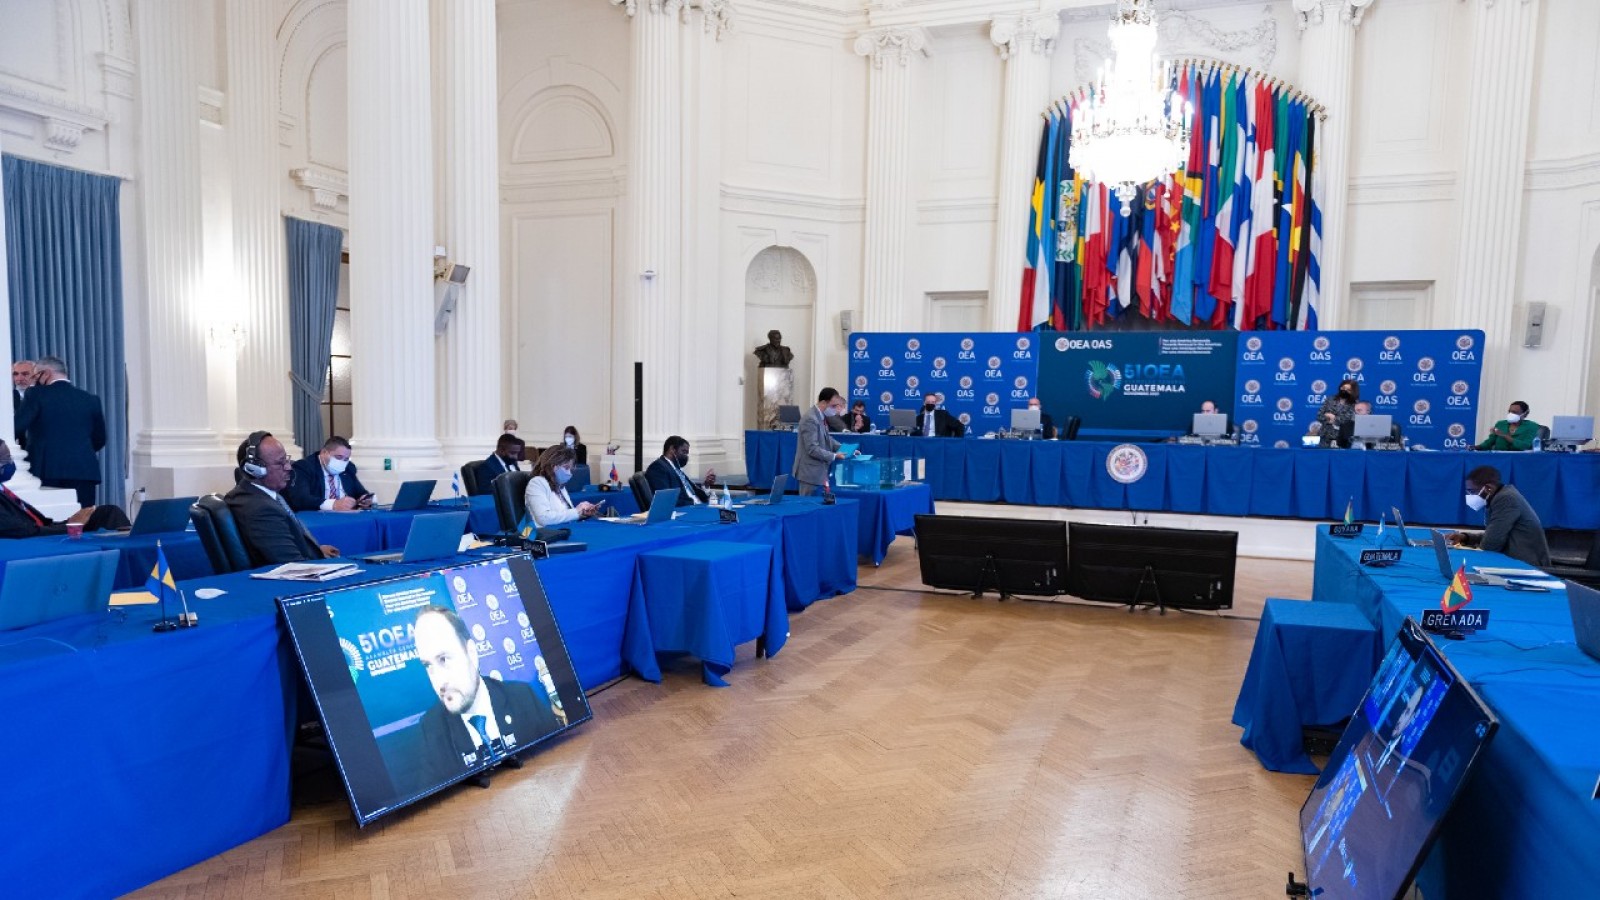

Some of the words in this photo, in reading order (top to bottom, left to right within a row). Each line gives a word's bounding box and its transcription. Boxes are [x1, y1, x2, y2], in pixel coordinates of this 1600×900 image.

[1070, 340, 1089, 349] OEA
[1092, 340, 1112, 349] OAS
[854, 351, 870, 359] OEA
[904, 352, 922, 360] OAS
[958, 351, 976, 360] OEA
[1014, 350, 1031, 359] OEA
[1243, 352, 1264, 360] OEA
[1310, 352, 1332, 360] OAS
[1380, 351, 1402, 360] OEA
[1452, 350, 1474, 360] OEA
[931, 370, 948, 378] OEA
[984, 370, 1002, 378] OEA
[1275, 372, 1296, 381] OEA
[1343, 372, 1364, 382] OEA
[1413, 372, 1436, 382] OEA
[956, 390, 974, 398] OAS
[1011, 390, 1029, 398] OEA
[1242, 395, 1262, 404] OEA
[1376, 396, 1398, 405] OAS
[1446, 396, 1470, 406] OEA
[984, 406, 1000, 414] OEA
[1274, 412, 1294, 422] OAS
[1410, 415, 1432, 424] OEA
[1444, 439, 1466, 447] OAS
[458, 592, 474, 602] OEA
[490, 610, 506, 620] OEA
[476, 640, 493, 652] OEA
[507, 654, 522, 666] OAS
